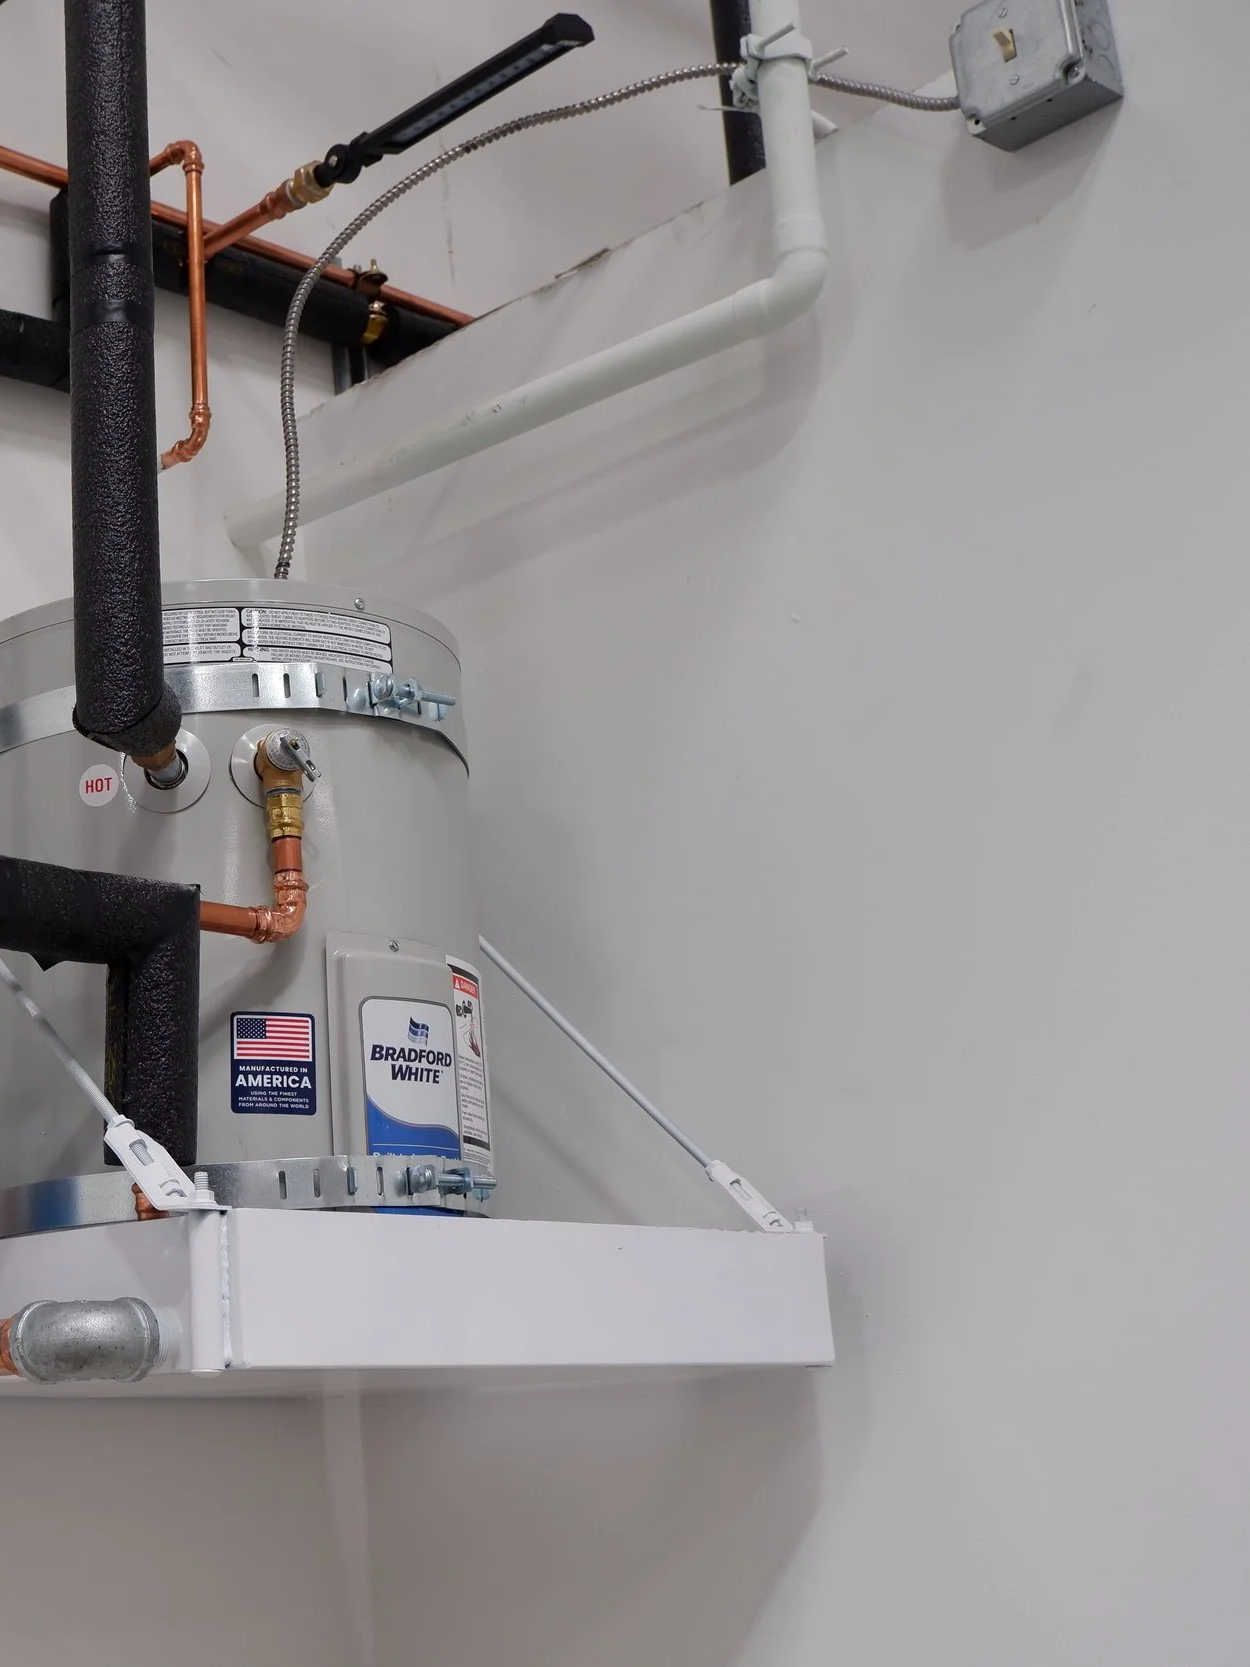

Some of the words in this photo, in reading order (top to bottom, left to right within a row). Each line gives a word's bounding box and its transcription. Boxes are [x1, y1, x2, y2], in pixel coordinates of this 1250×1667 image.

[86, 777, 112, 794] HOT
[370, 1044, 452, 1068] BRADFORD
[239, 1065, 298, 1073] MANUFACTURED
[391, 1064, 440, 1084] WHITE
[235, 1074, 312, 1089] AMERICA
